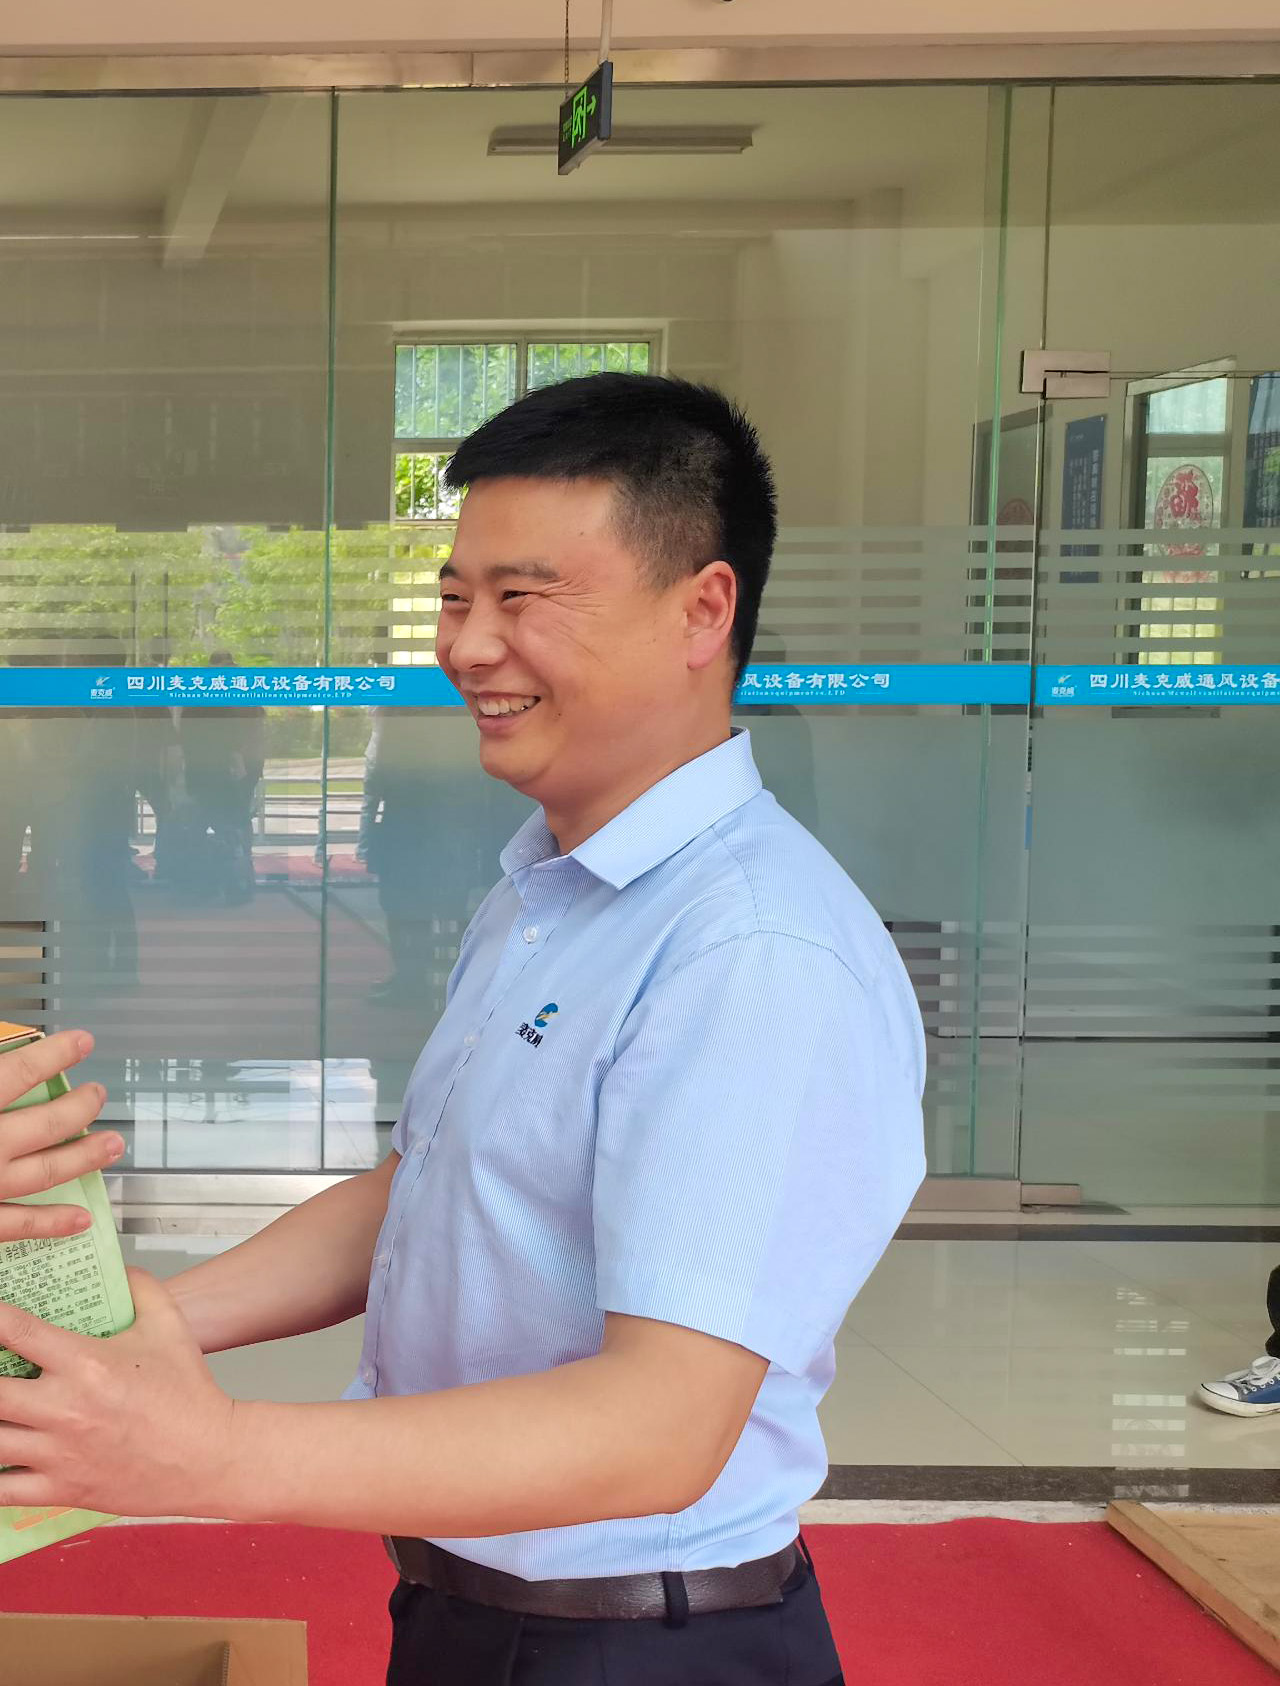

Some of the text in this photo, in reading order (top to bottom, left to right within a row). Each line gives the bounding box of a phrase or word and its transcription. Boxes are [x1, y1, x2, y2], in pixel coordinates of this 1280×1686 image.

[127, 675, 396, 691] 四川麦克威通风设备有限公司
